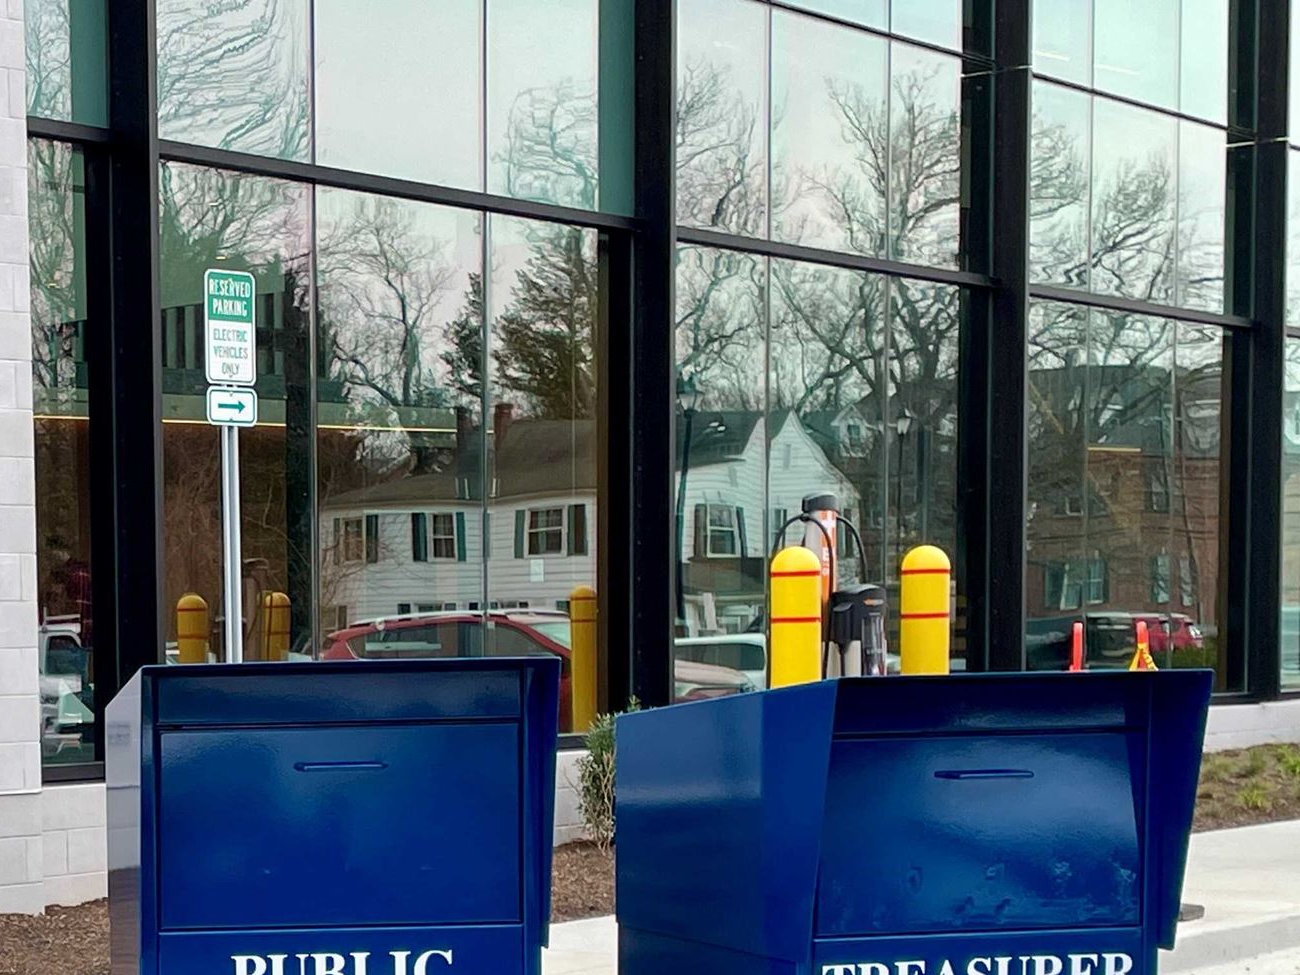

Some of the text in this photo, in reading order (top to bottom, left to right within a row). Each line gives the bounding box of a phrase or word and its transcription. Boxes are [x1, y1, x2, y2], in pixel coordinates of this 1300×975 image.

[208, 278, 251, 298] RESERVED
[212, 299, 248, 317] PARKING
[213, 328, 248, 343] ELECTRIC
[213, 345, 248, 360] VEHICLES
[221, 362, 240, 375] ONLY
